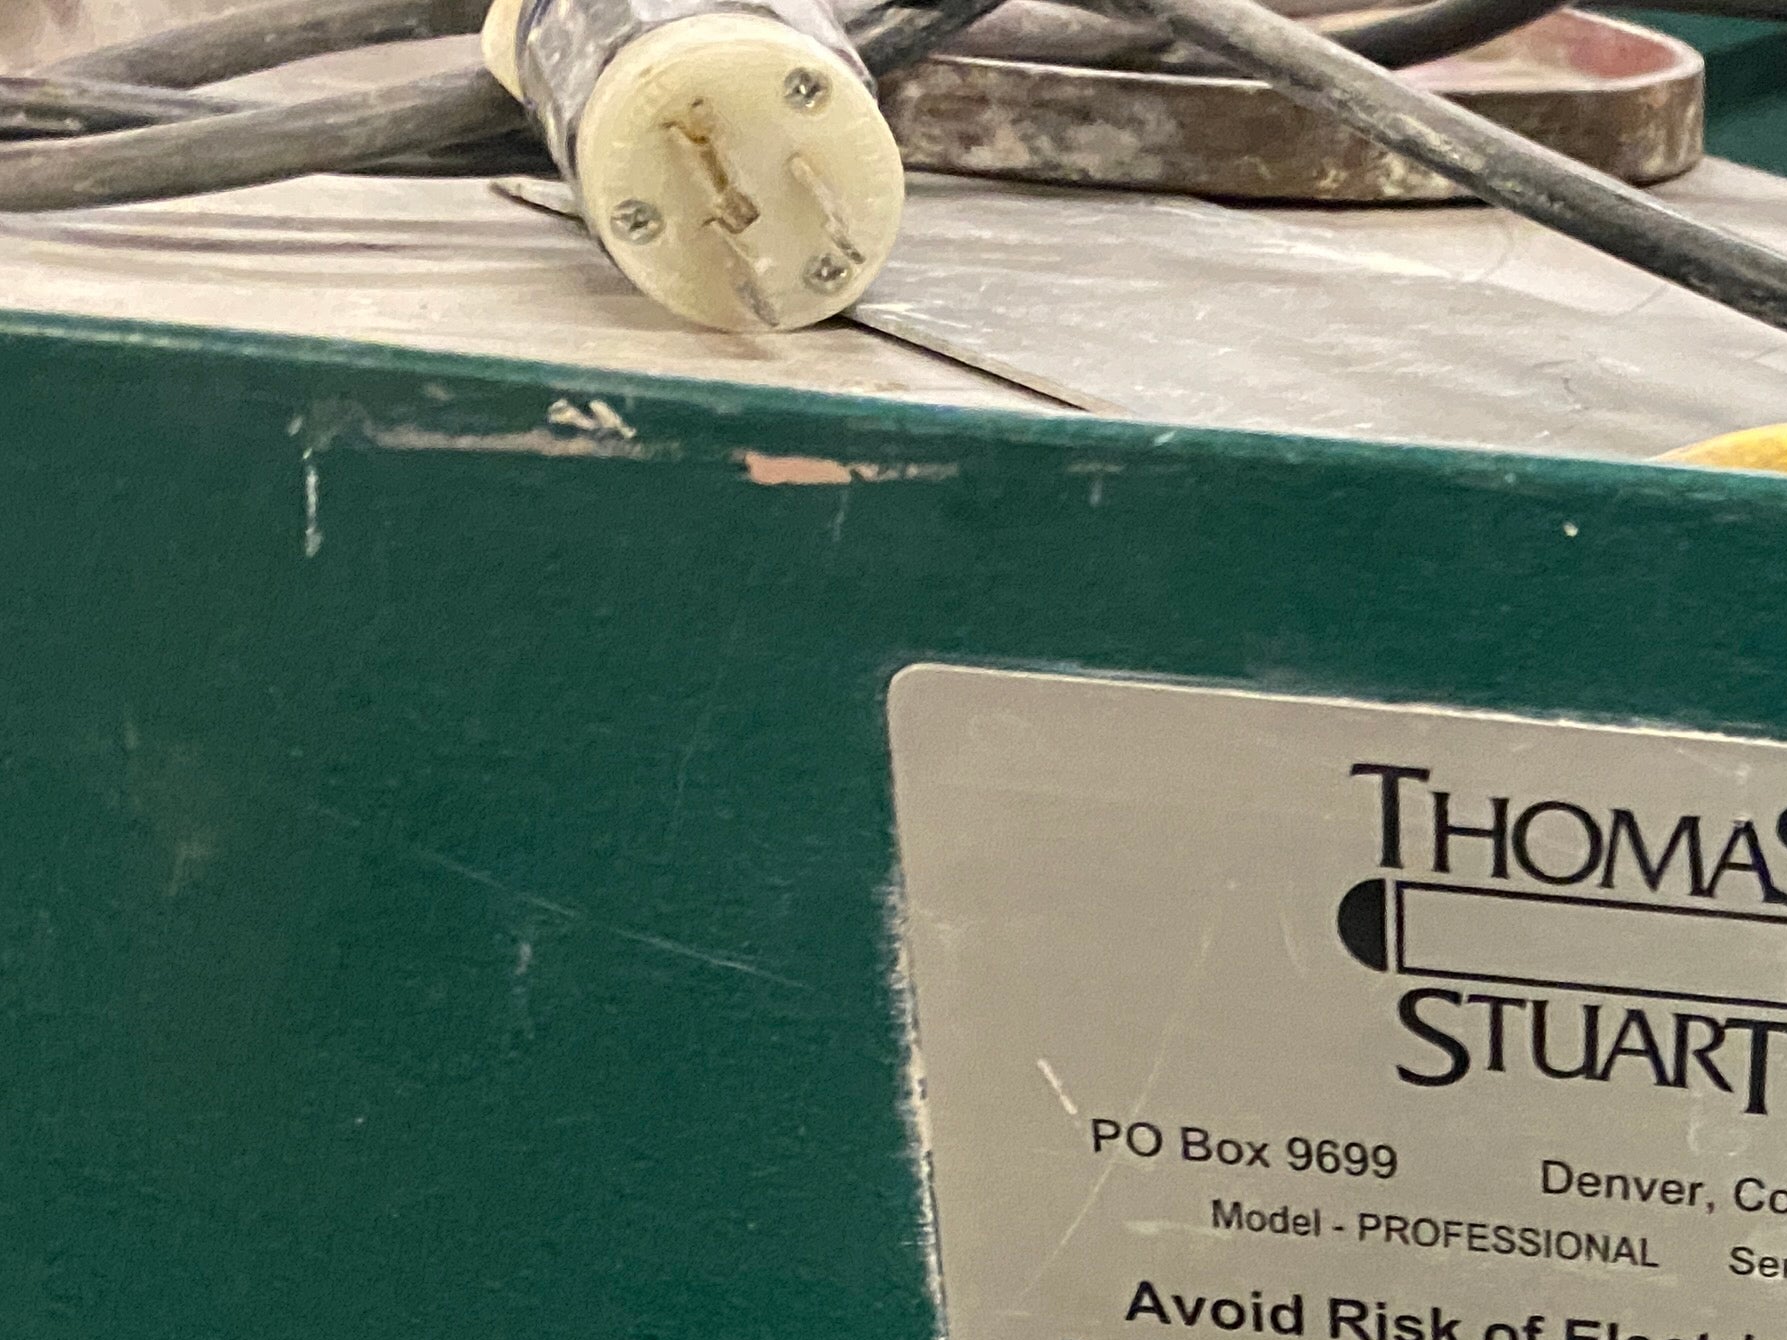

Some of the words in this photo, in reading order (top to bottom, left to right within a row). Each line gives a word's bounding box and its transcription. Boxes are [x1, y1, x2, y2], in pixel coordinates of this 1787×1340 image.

[1091, 1117, 1164, 1158] PO
[1180, 1126, 1271, 1169] Box
[1286, 1136, 1399, 1180] 9699
[1540, 1159, 1717, 1214] Denver,
[1210, 1199, 1322, 1237] Model
[1357, 1212, 1660, 1269] PROFESSIONAL
[1124, 1280, 1304, 1337] Avoid
